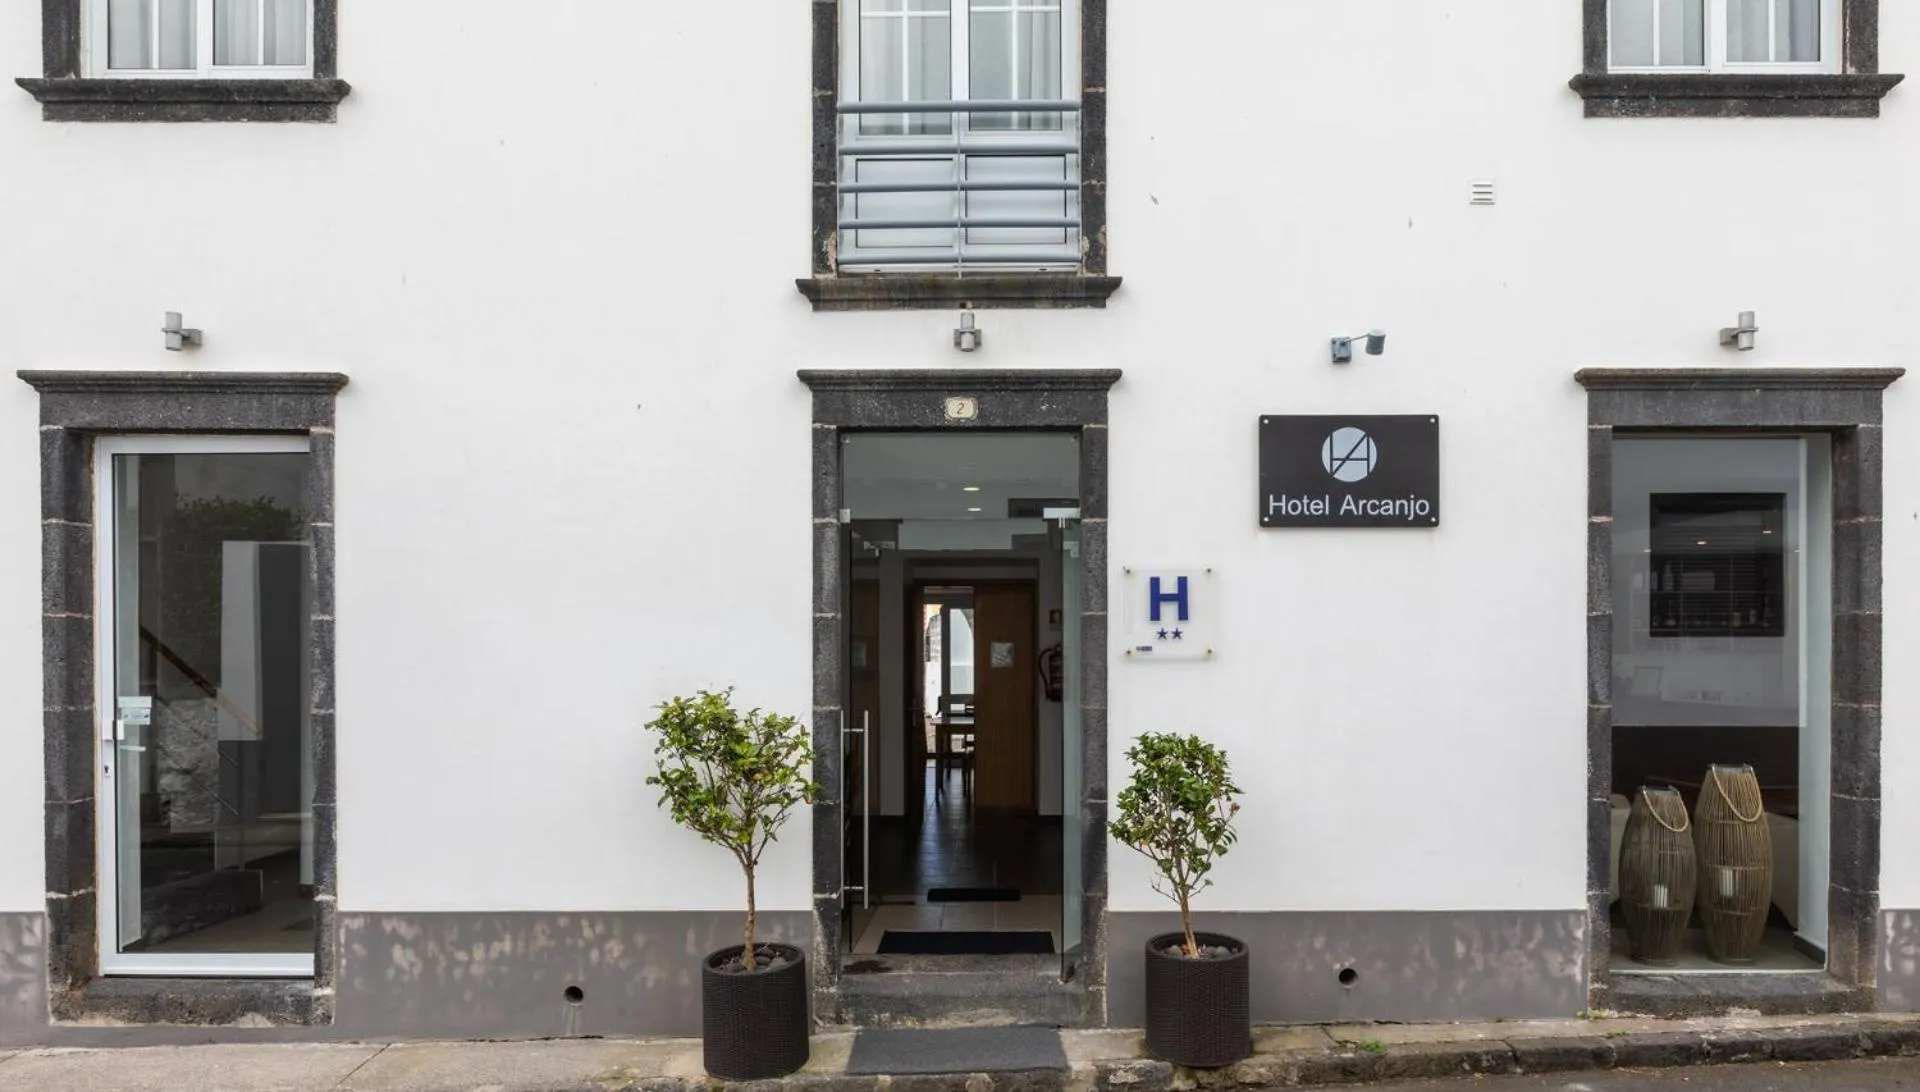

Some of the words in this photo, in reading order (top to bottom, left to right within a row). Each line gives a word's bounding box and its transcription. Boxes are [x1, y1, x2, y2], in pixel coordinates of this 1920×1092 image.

[956, 402, 965, 415] 2
[1268, 494, 1330, 516] Hotel
[1339, 494, 1430, 521] Arcanjo
[1149, 576, 1188, 621] H
